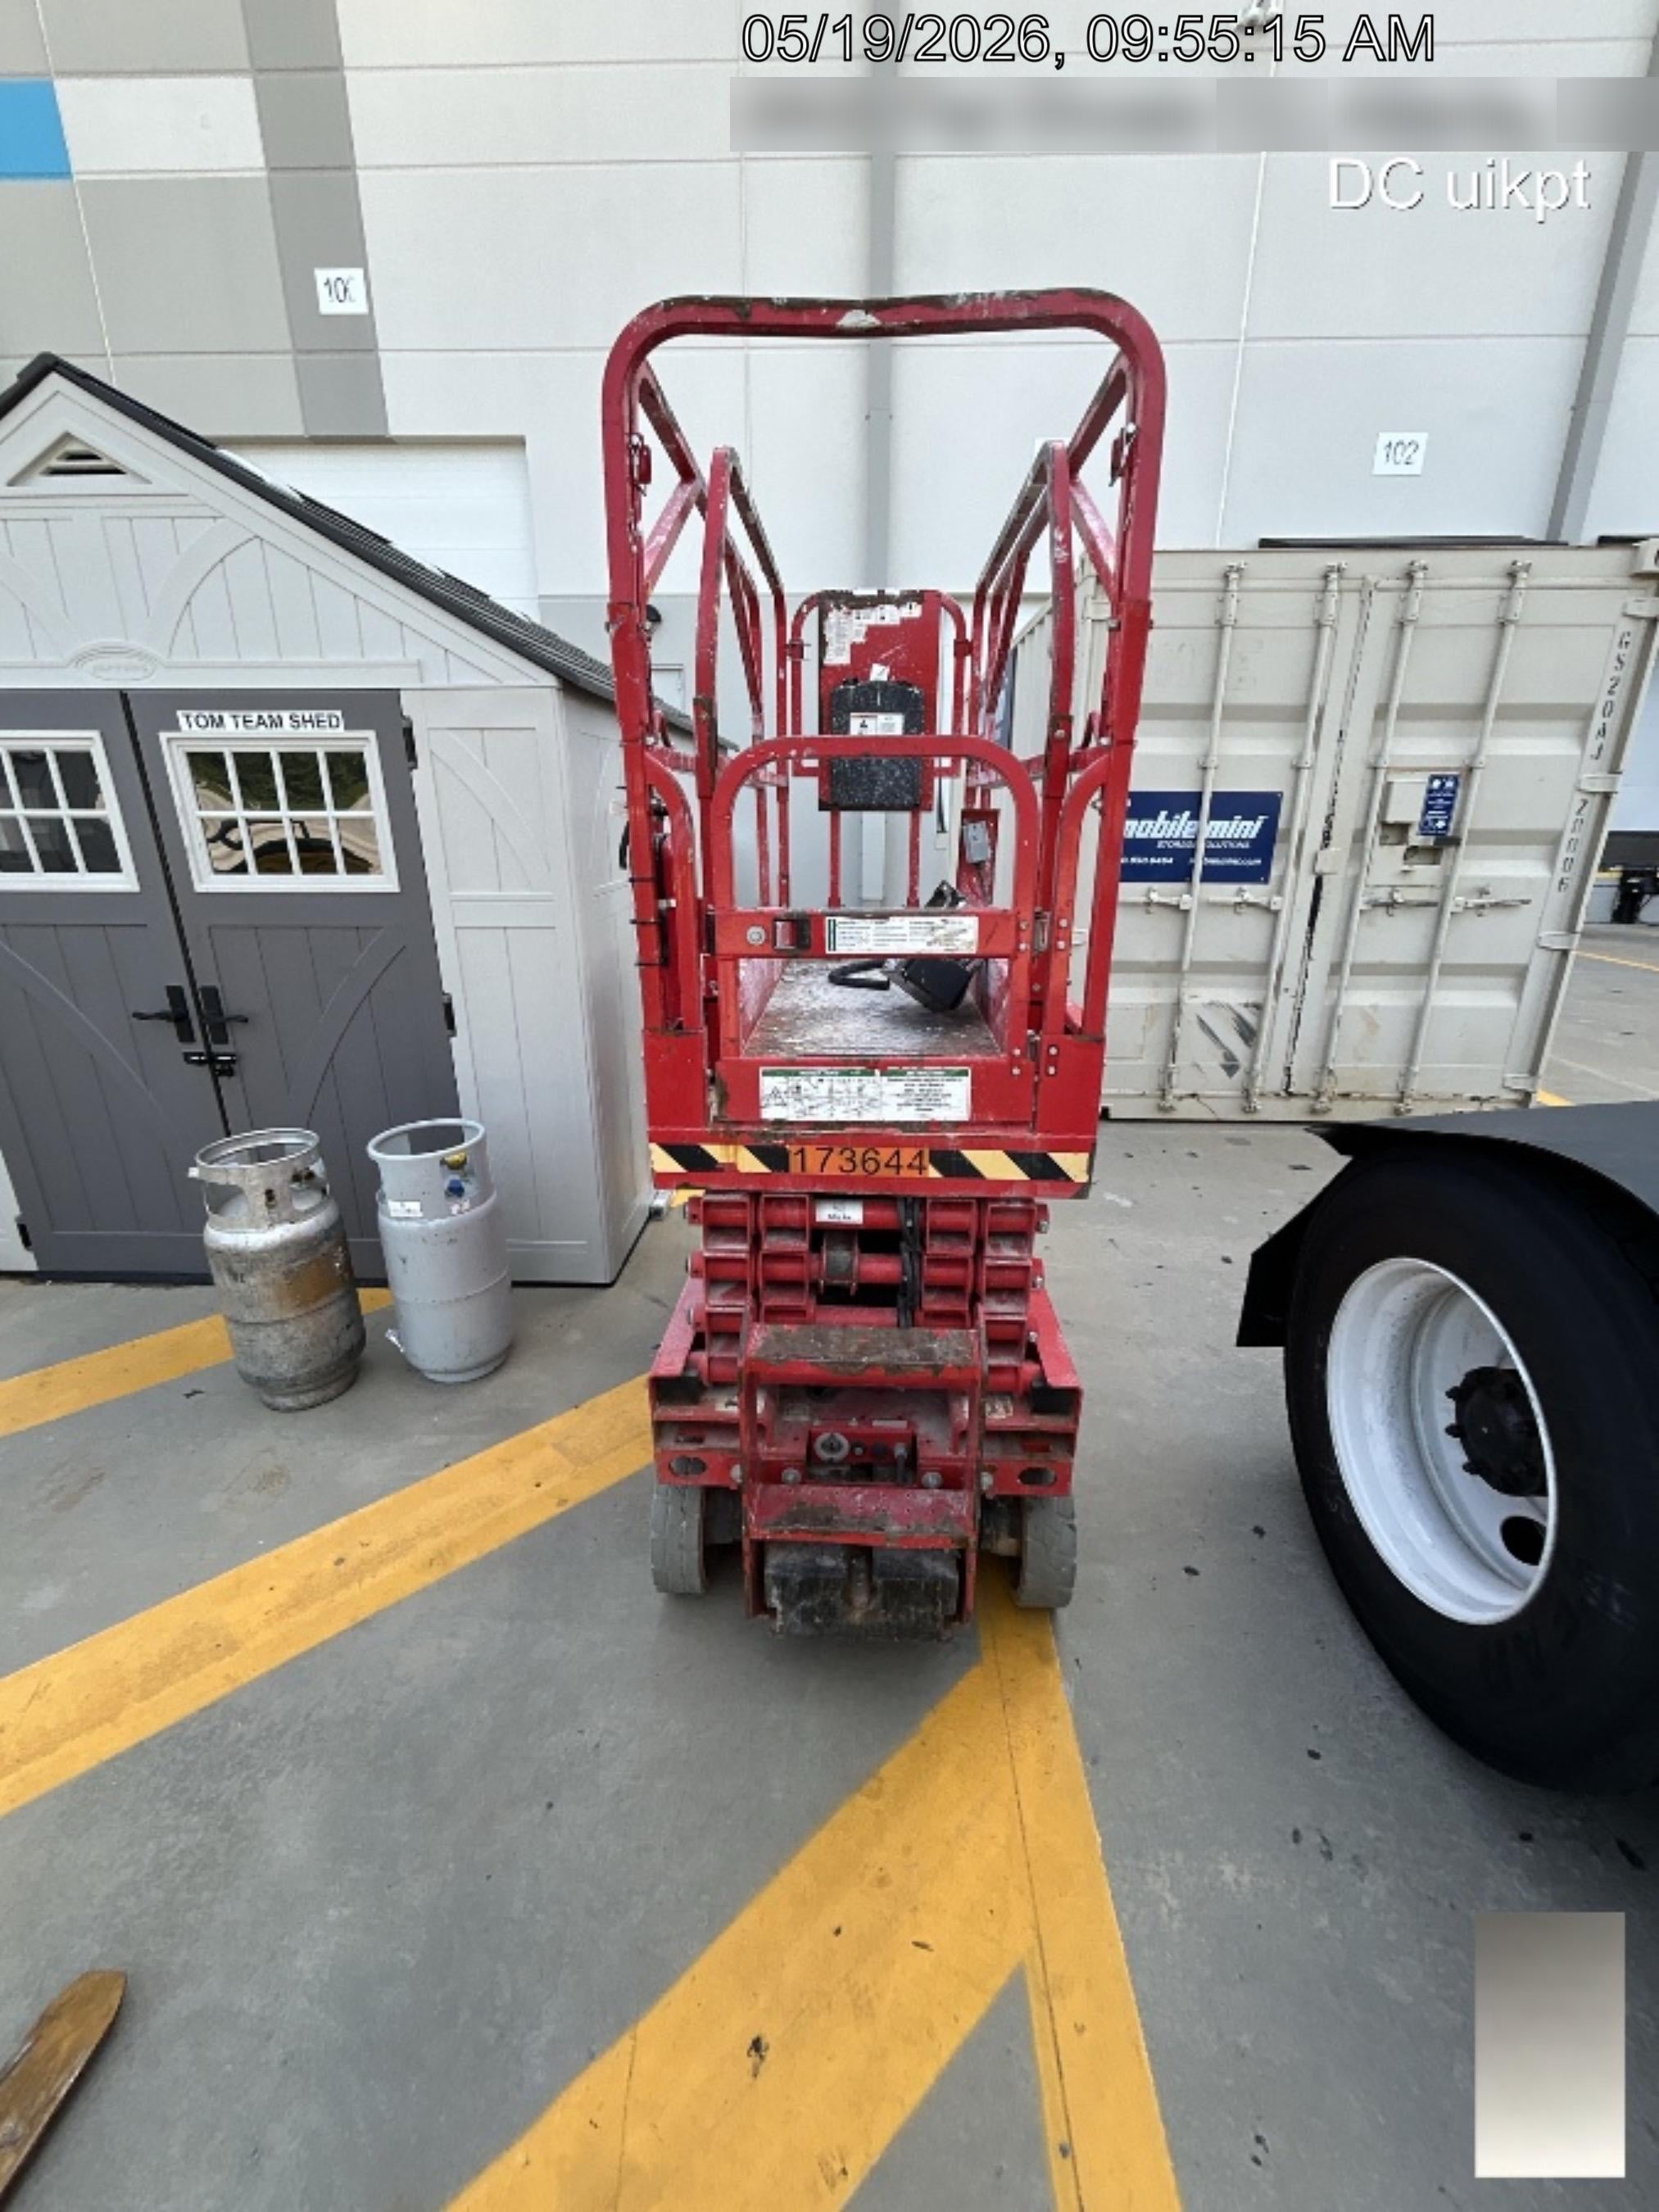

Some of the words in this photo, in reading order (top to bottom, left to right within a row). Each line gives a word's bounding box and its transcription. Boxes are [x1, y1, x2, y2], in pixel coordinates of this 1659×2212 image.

[1383, 439, 1419, 465] 102
[184, 714, 224, 729] TOM
[230, 714, 283, 729] TEAM
[289, 714, 340, 729] SHED
[793, 1147, 927, 1175] 173644
